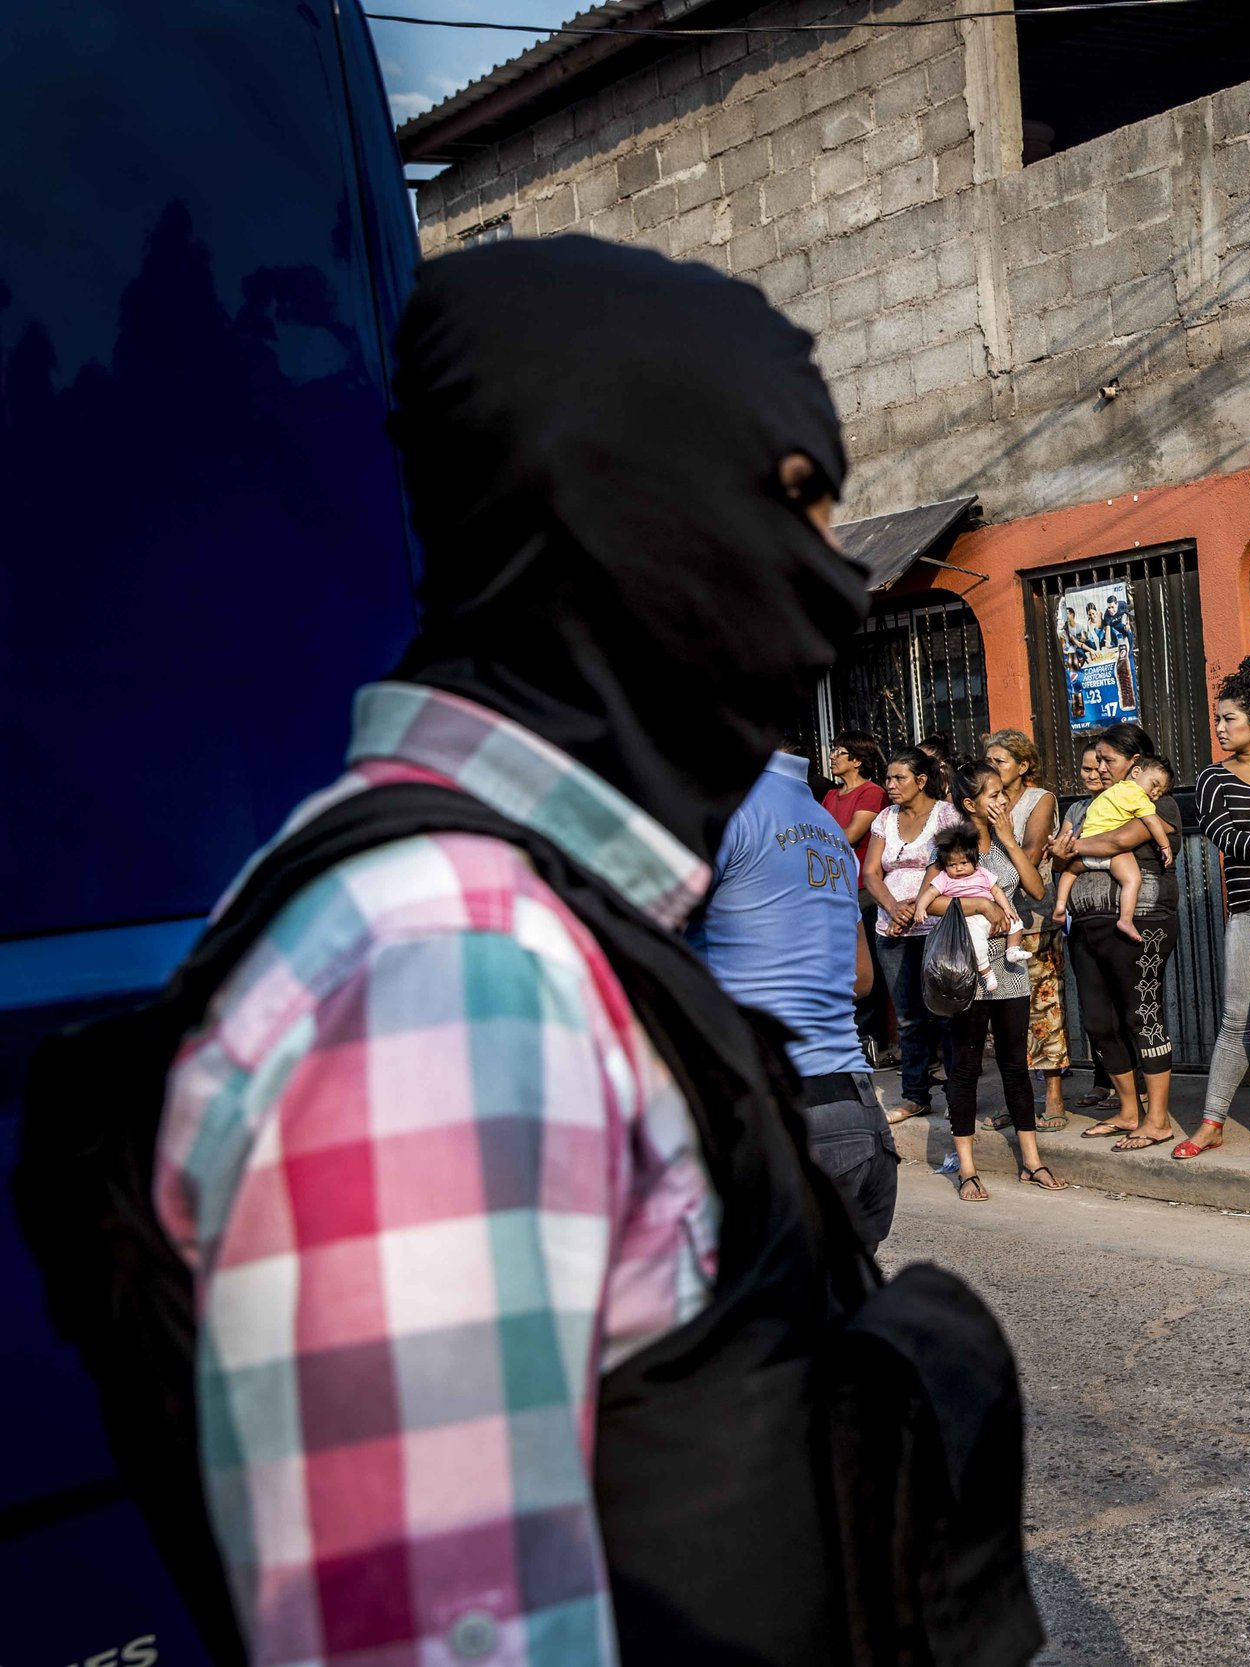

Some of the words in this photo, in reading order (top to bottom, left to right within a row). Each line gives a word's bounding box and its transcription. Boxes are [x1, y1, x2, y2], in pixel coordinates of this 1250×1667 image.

[1084, 663, 1114, 676] COMPARTE
[1082, 670, 1112, 682] HISTORIAS
[1081, 677, 1116, 689] DIFERENTES
[806, 847, 854, 898] DPI
